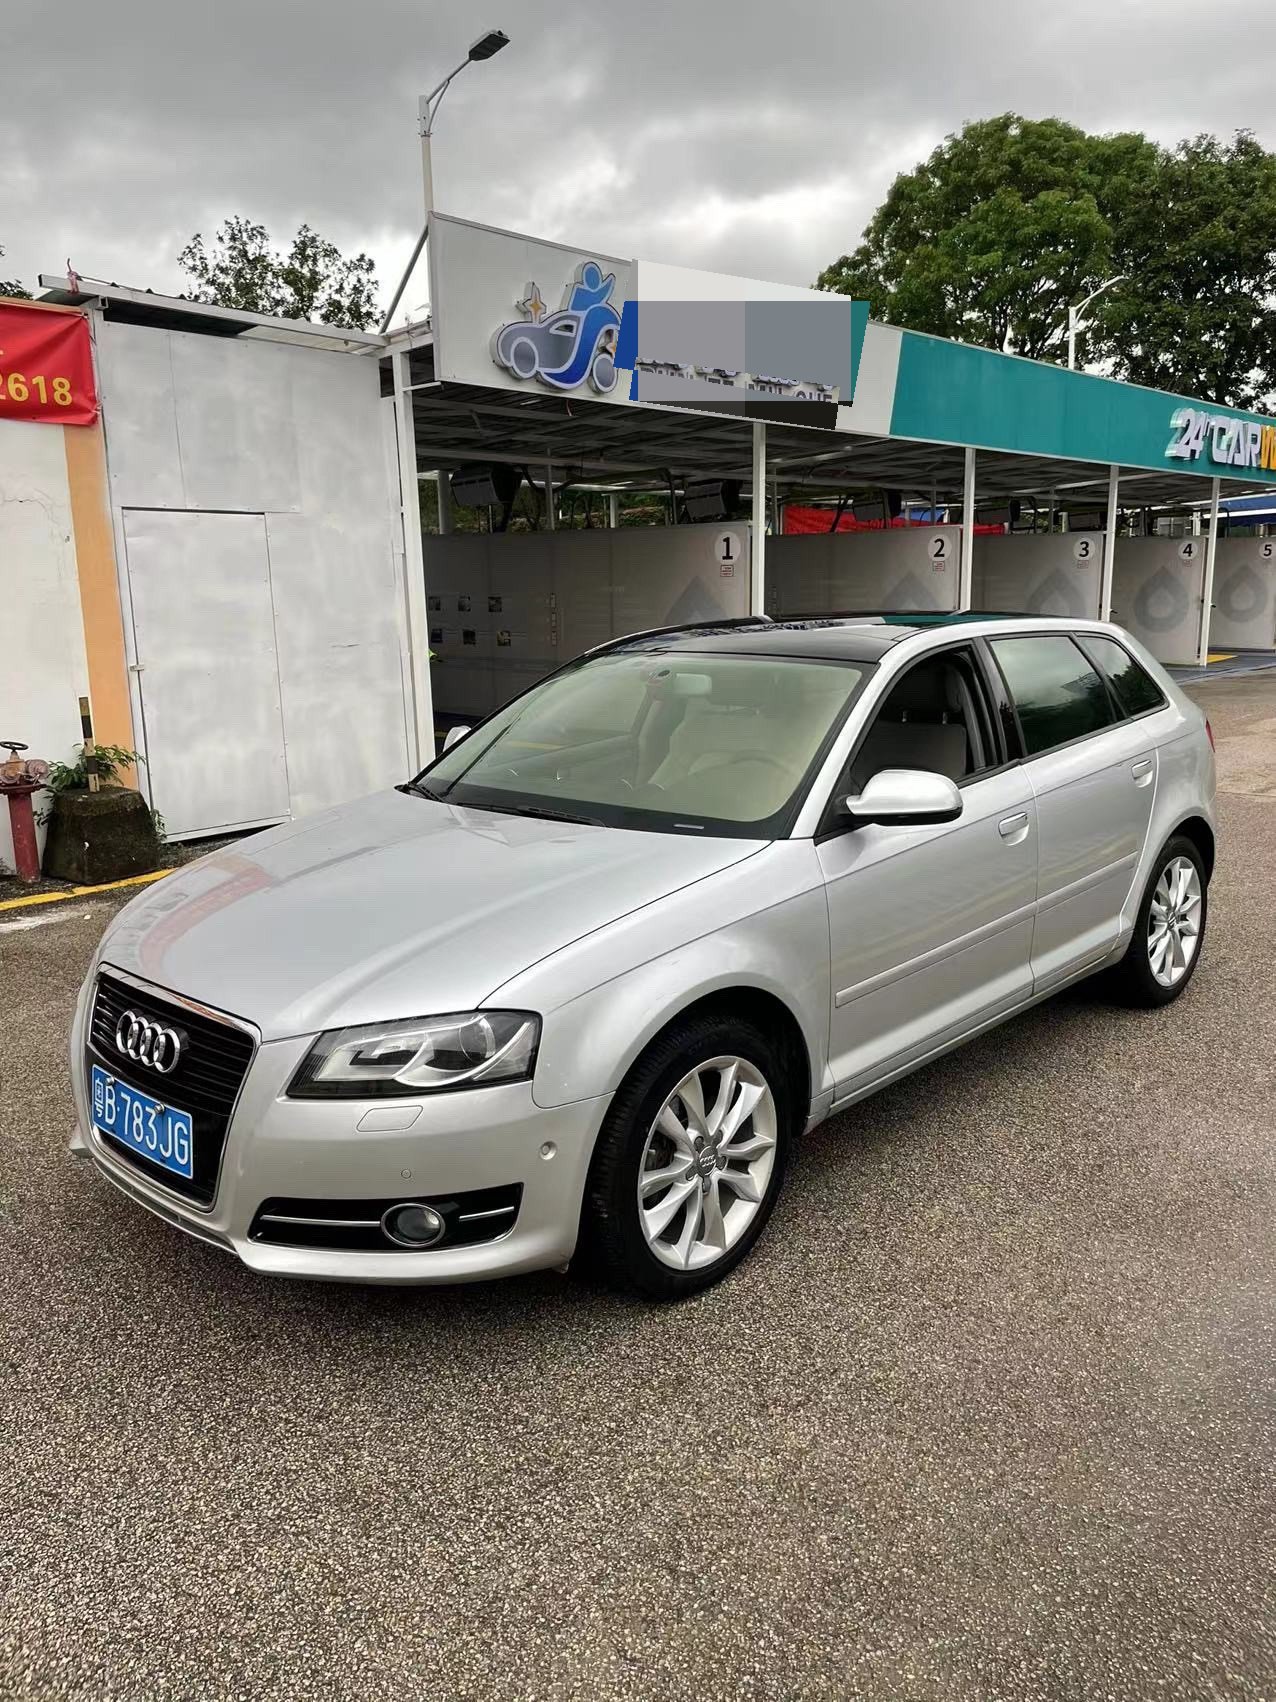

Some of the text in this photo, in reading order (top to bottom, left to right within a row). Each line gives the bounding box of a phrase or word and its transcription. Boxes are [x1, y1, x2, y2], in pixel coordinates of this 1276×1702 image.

[722, 536, 734, 560] 1
[933, 538, 945, 558] 2
[1079, 541, 1090, 558] 3
[1182, 543, 1193, 557] 4
[1263, 544, 1272, 557] 5
